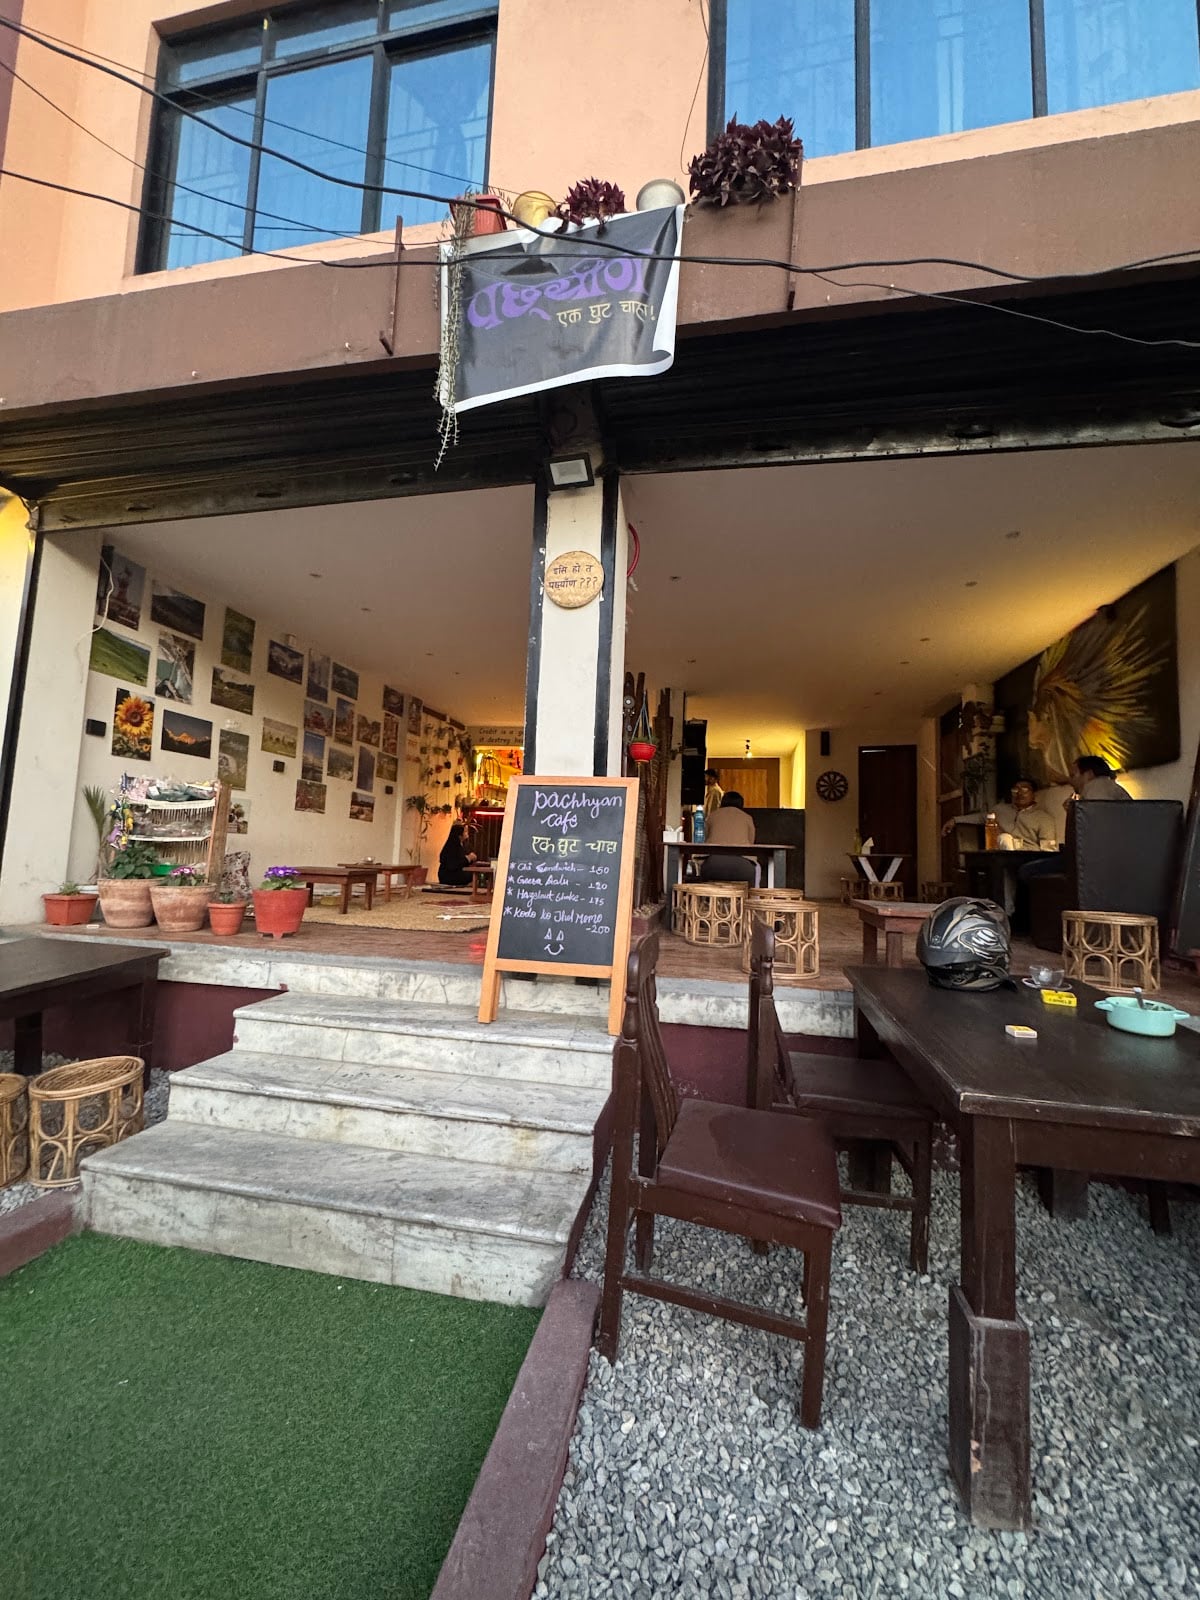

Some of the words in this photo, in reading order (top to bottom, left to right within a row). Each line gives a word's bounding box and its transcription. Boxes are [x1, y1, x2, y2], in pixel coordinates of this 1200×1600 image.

[556, 309, 583, 328] एक
[531, 836, 555, 855] एक
[588, 865, 610, 875] 150
[588, 881, 608, 890] 120
[588, 896, 605, 906] 175
